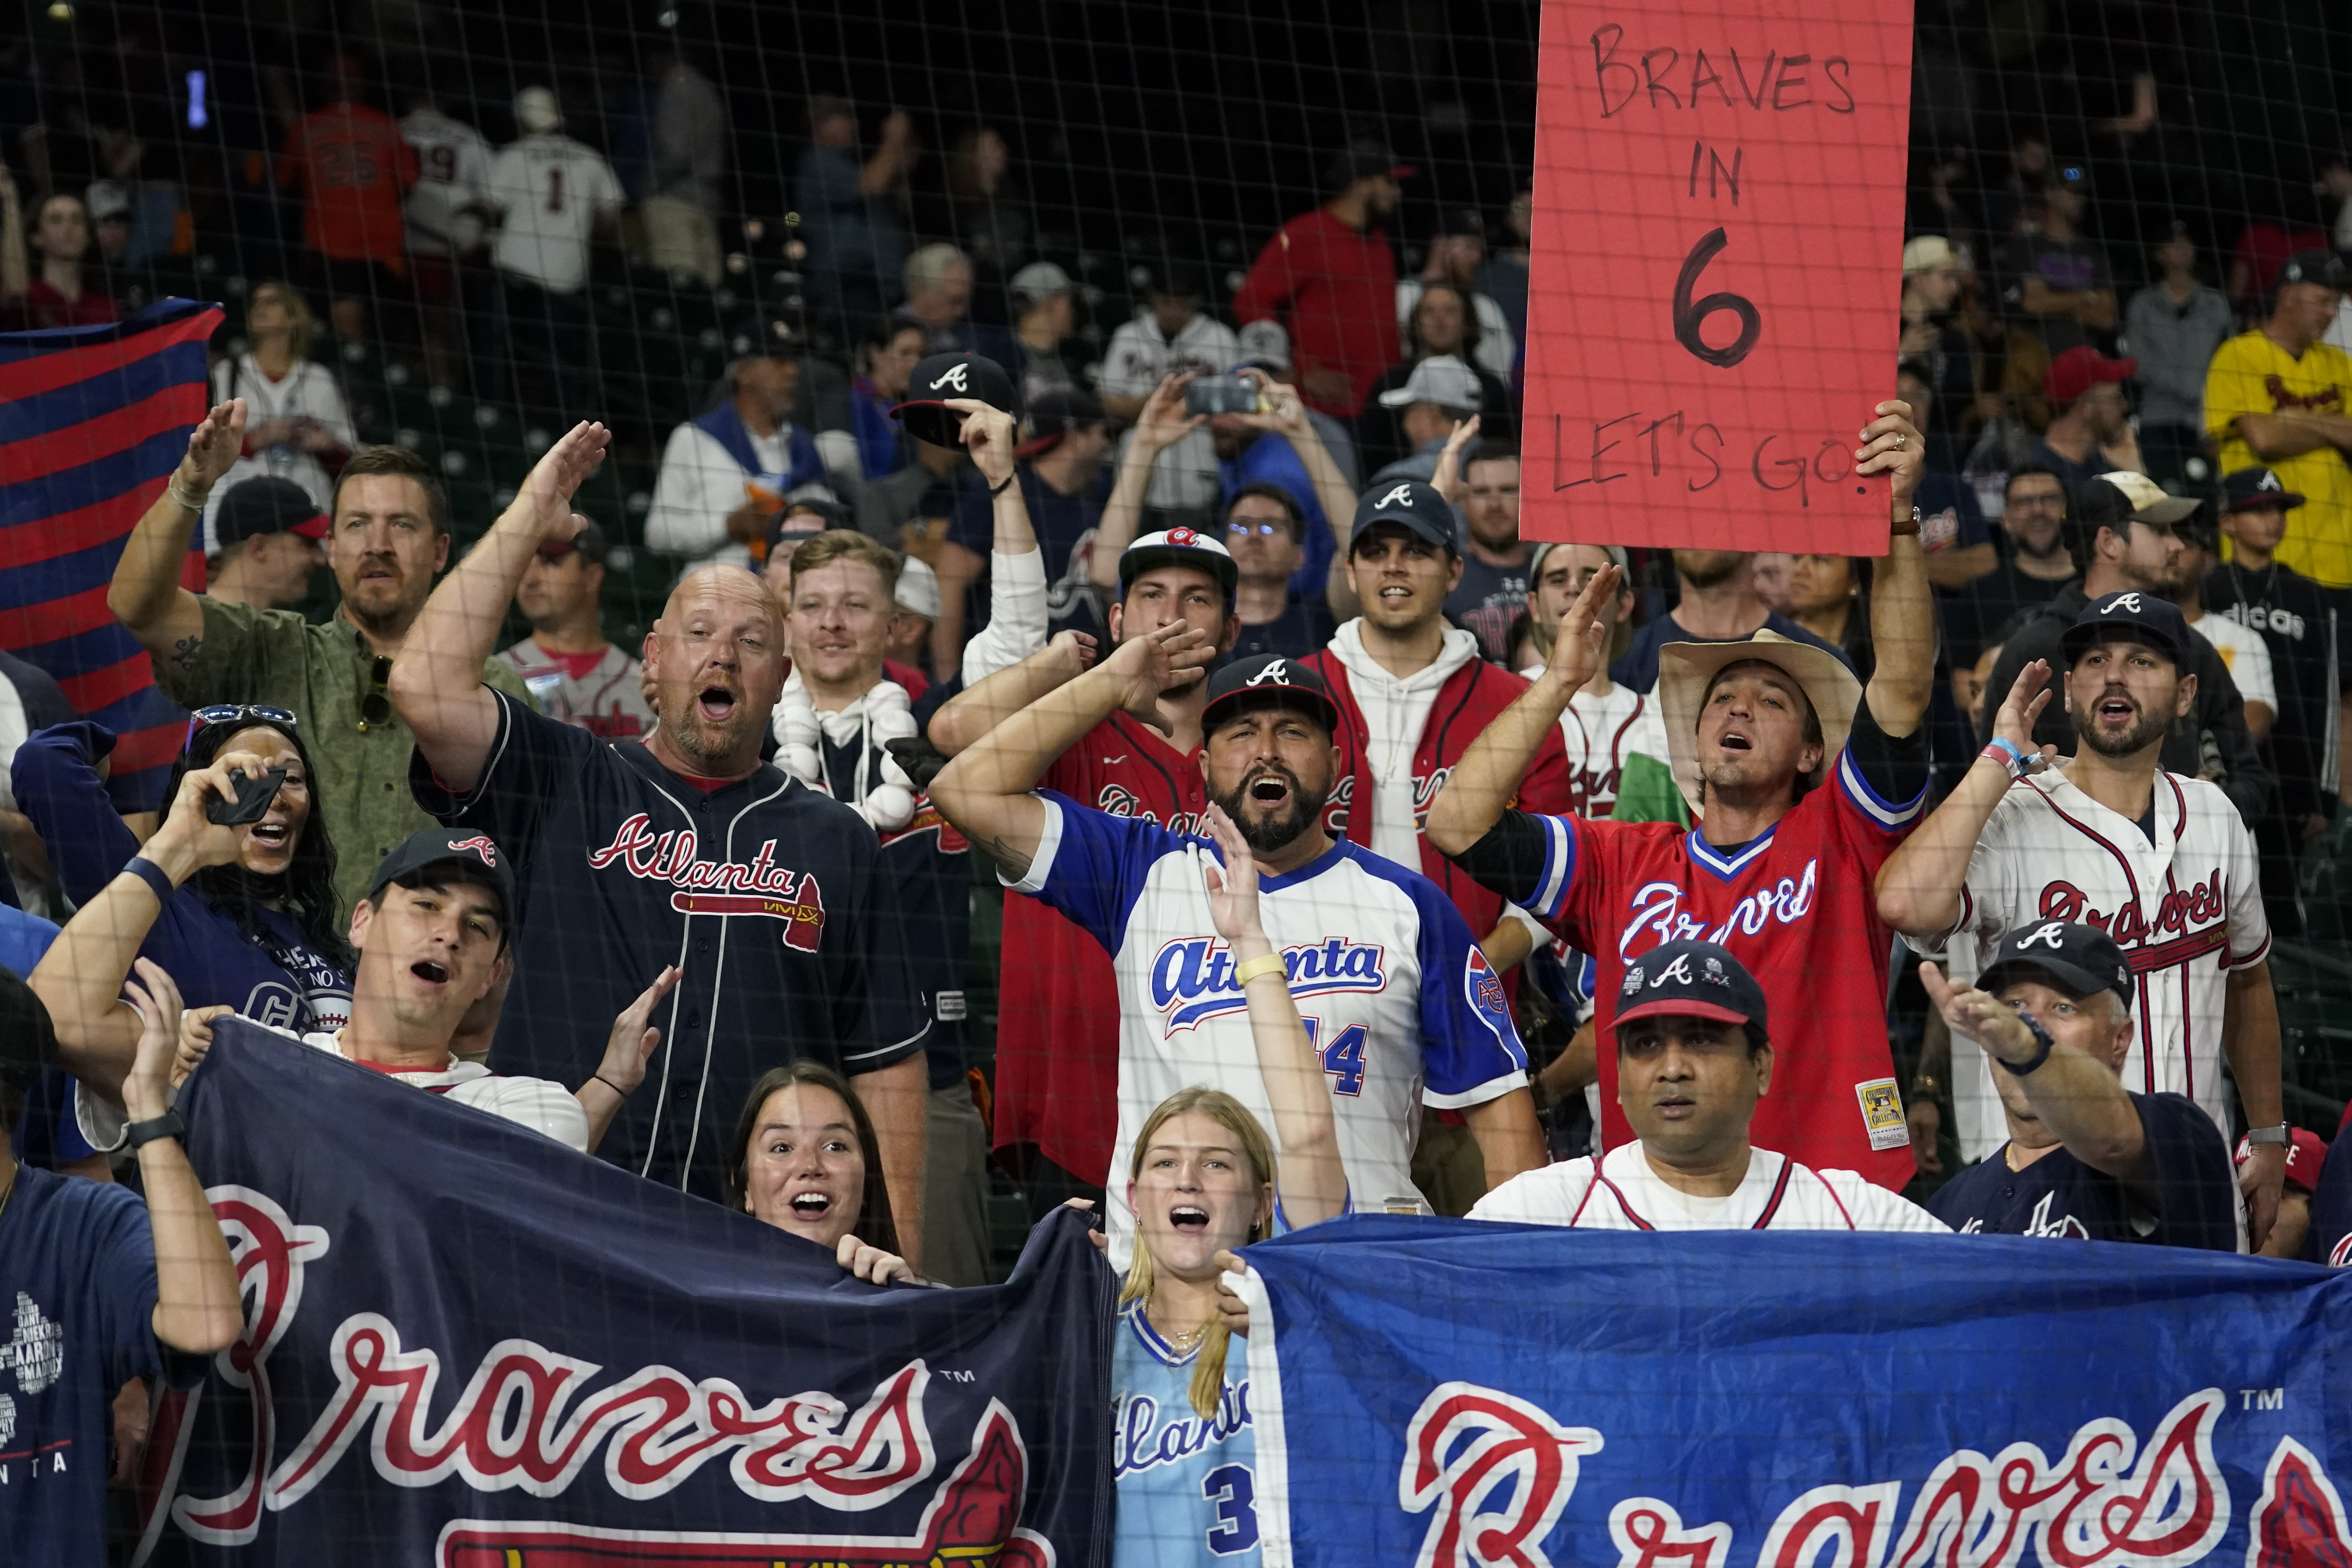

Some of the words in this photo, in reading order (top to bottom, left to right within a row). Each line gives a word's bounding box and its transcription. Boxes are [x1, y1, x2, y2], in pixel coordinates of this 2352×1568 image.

[1591, 23, 1855, 118] BRAVES
[1689, 140, 1742, 207] IN
[1672, 227, 1761, 369] 6
[1553, 410, 1725, 492] LET'S
[1752, 419, 1867, 507] GO
[586, 812, 795, 894] Atlanta
[309, 970, 333, 987] NO
[939, 1368, 976, 1384] TM
[2240, 1388, 2284, 1411] TM
